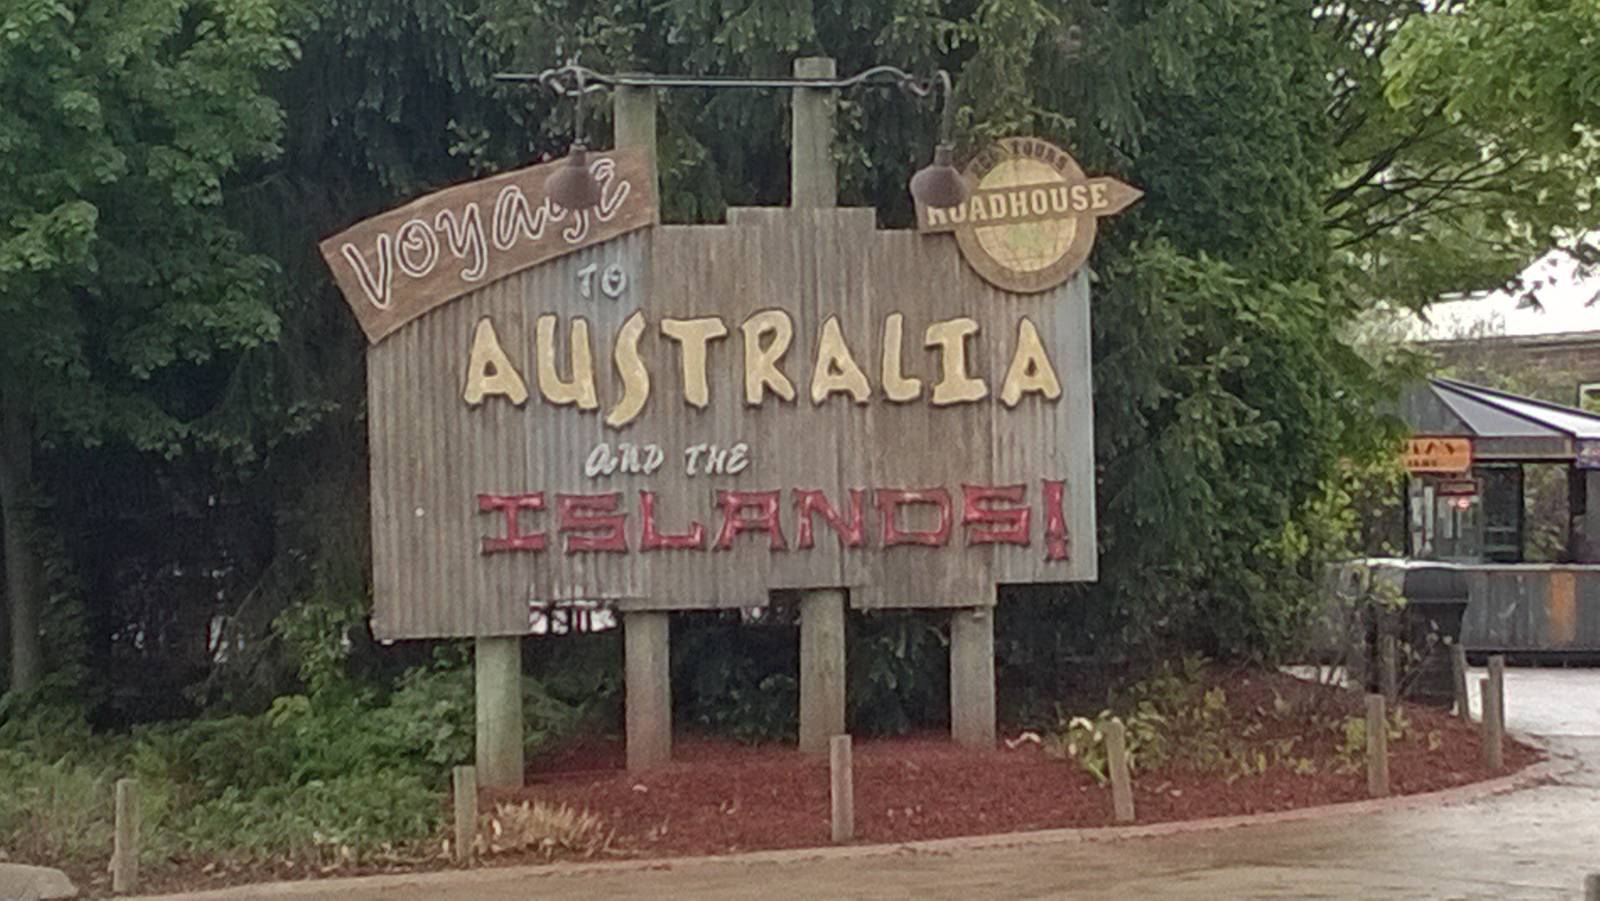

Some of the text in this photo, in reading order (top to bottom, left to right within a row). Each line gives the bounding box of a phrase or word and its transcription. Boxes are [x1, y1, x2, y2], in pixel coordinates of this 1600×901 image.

[577, 263, 627, 298] TO
[463, 310, 1062, 427] AUSTRALIA
[685, 442, 750, 476] THE
[476, 478, 1070, 562] ISLANDS!
